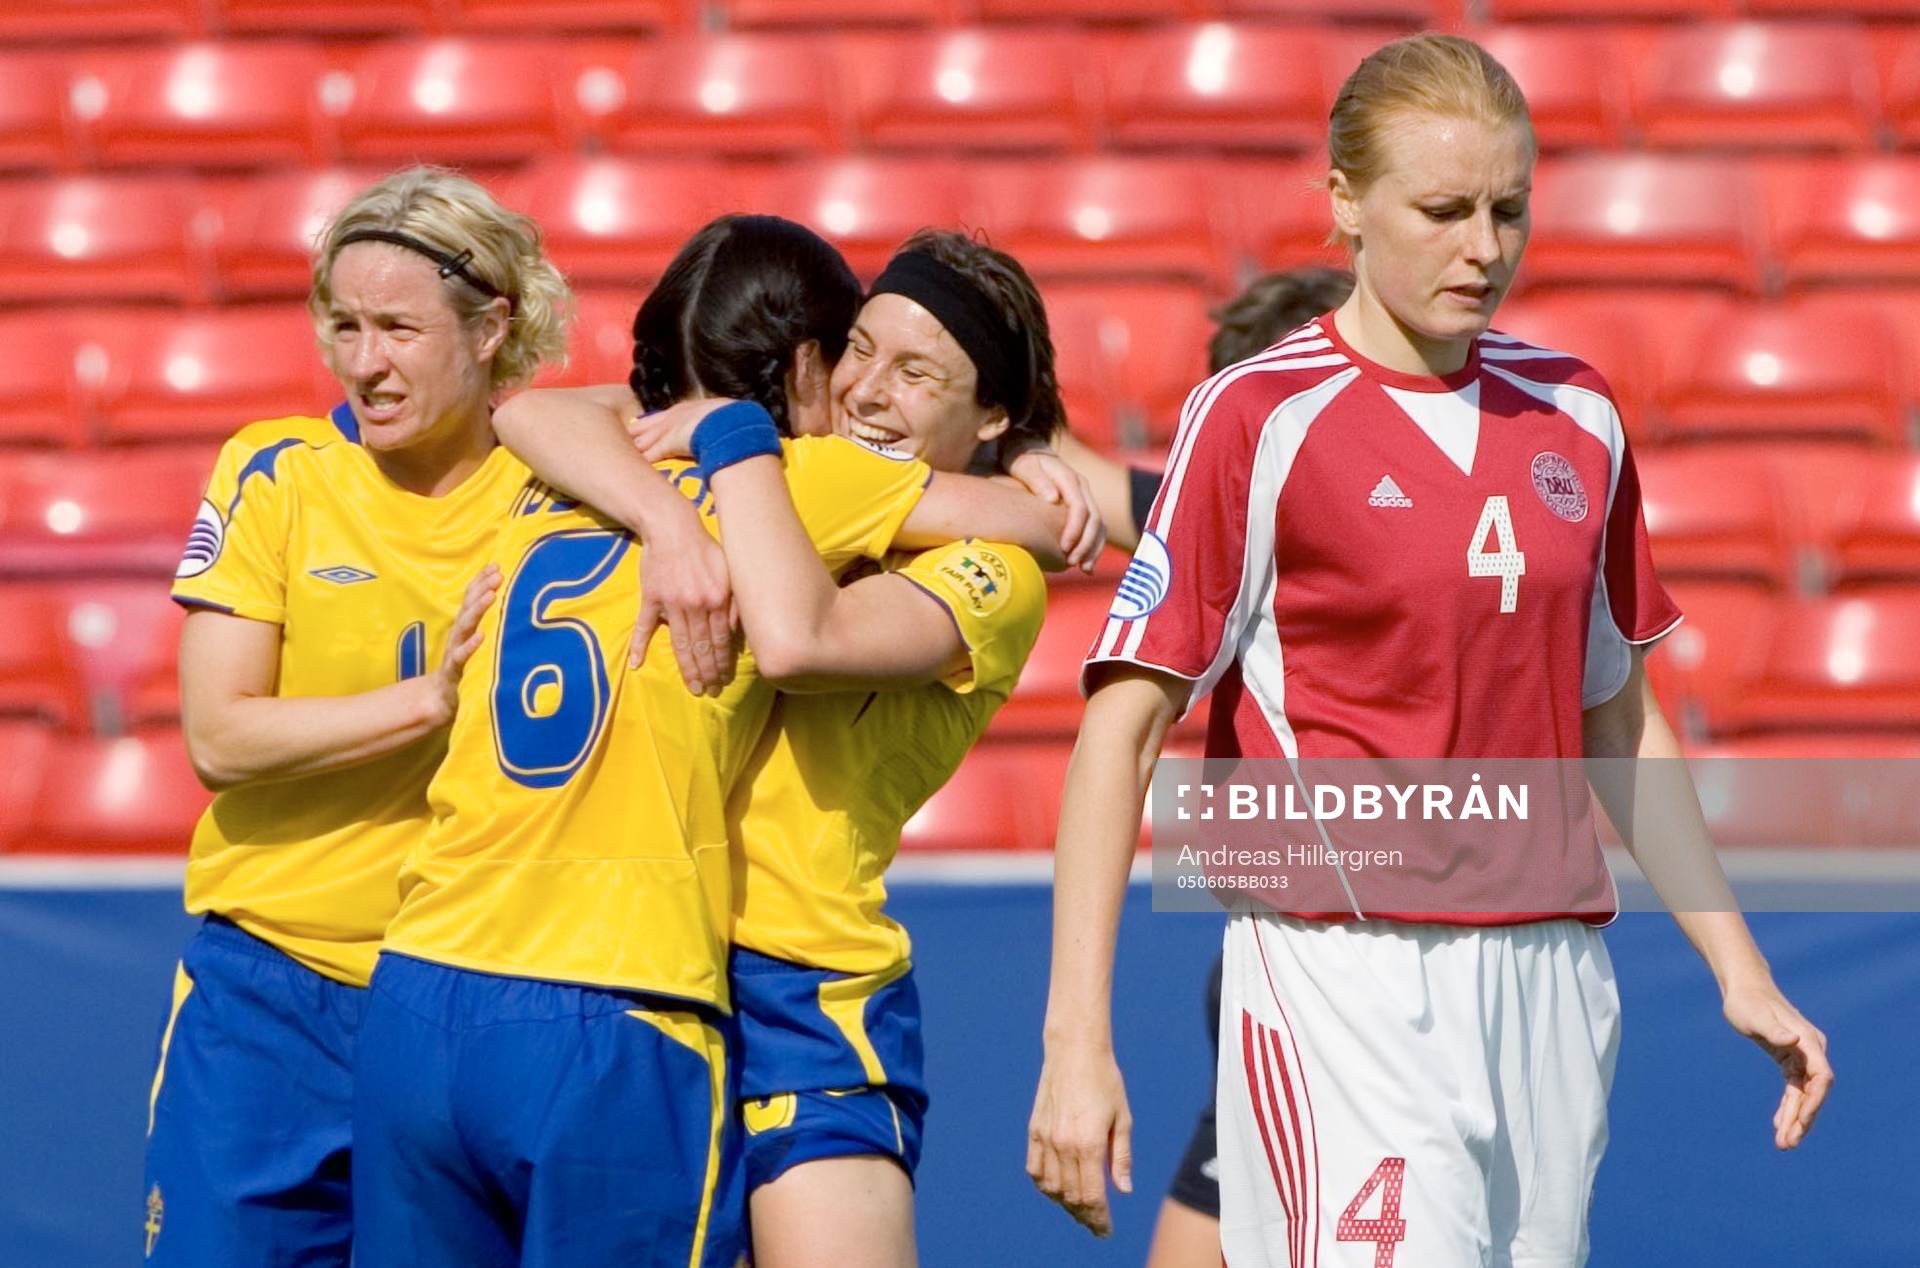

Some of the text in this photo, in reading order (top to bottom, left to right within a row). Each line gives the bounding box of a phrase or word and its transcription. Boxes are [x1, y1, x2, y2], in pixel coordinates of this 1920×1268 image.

[1368, 497, 1413, 508] adidas
[1467, 496, 1525, 613] 4
[490, 527, 634, 788] 6
[1336, 1157, 1406, 1268] 4
